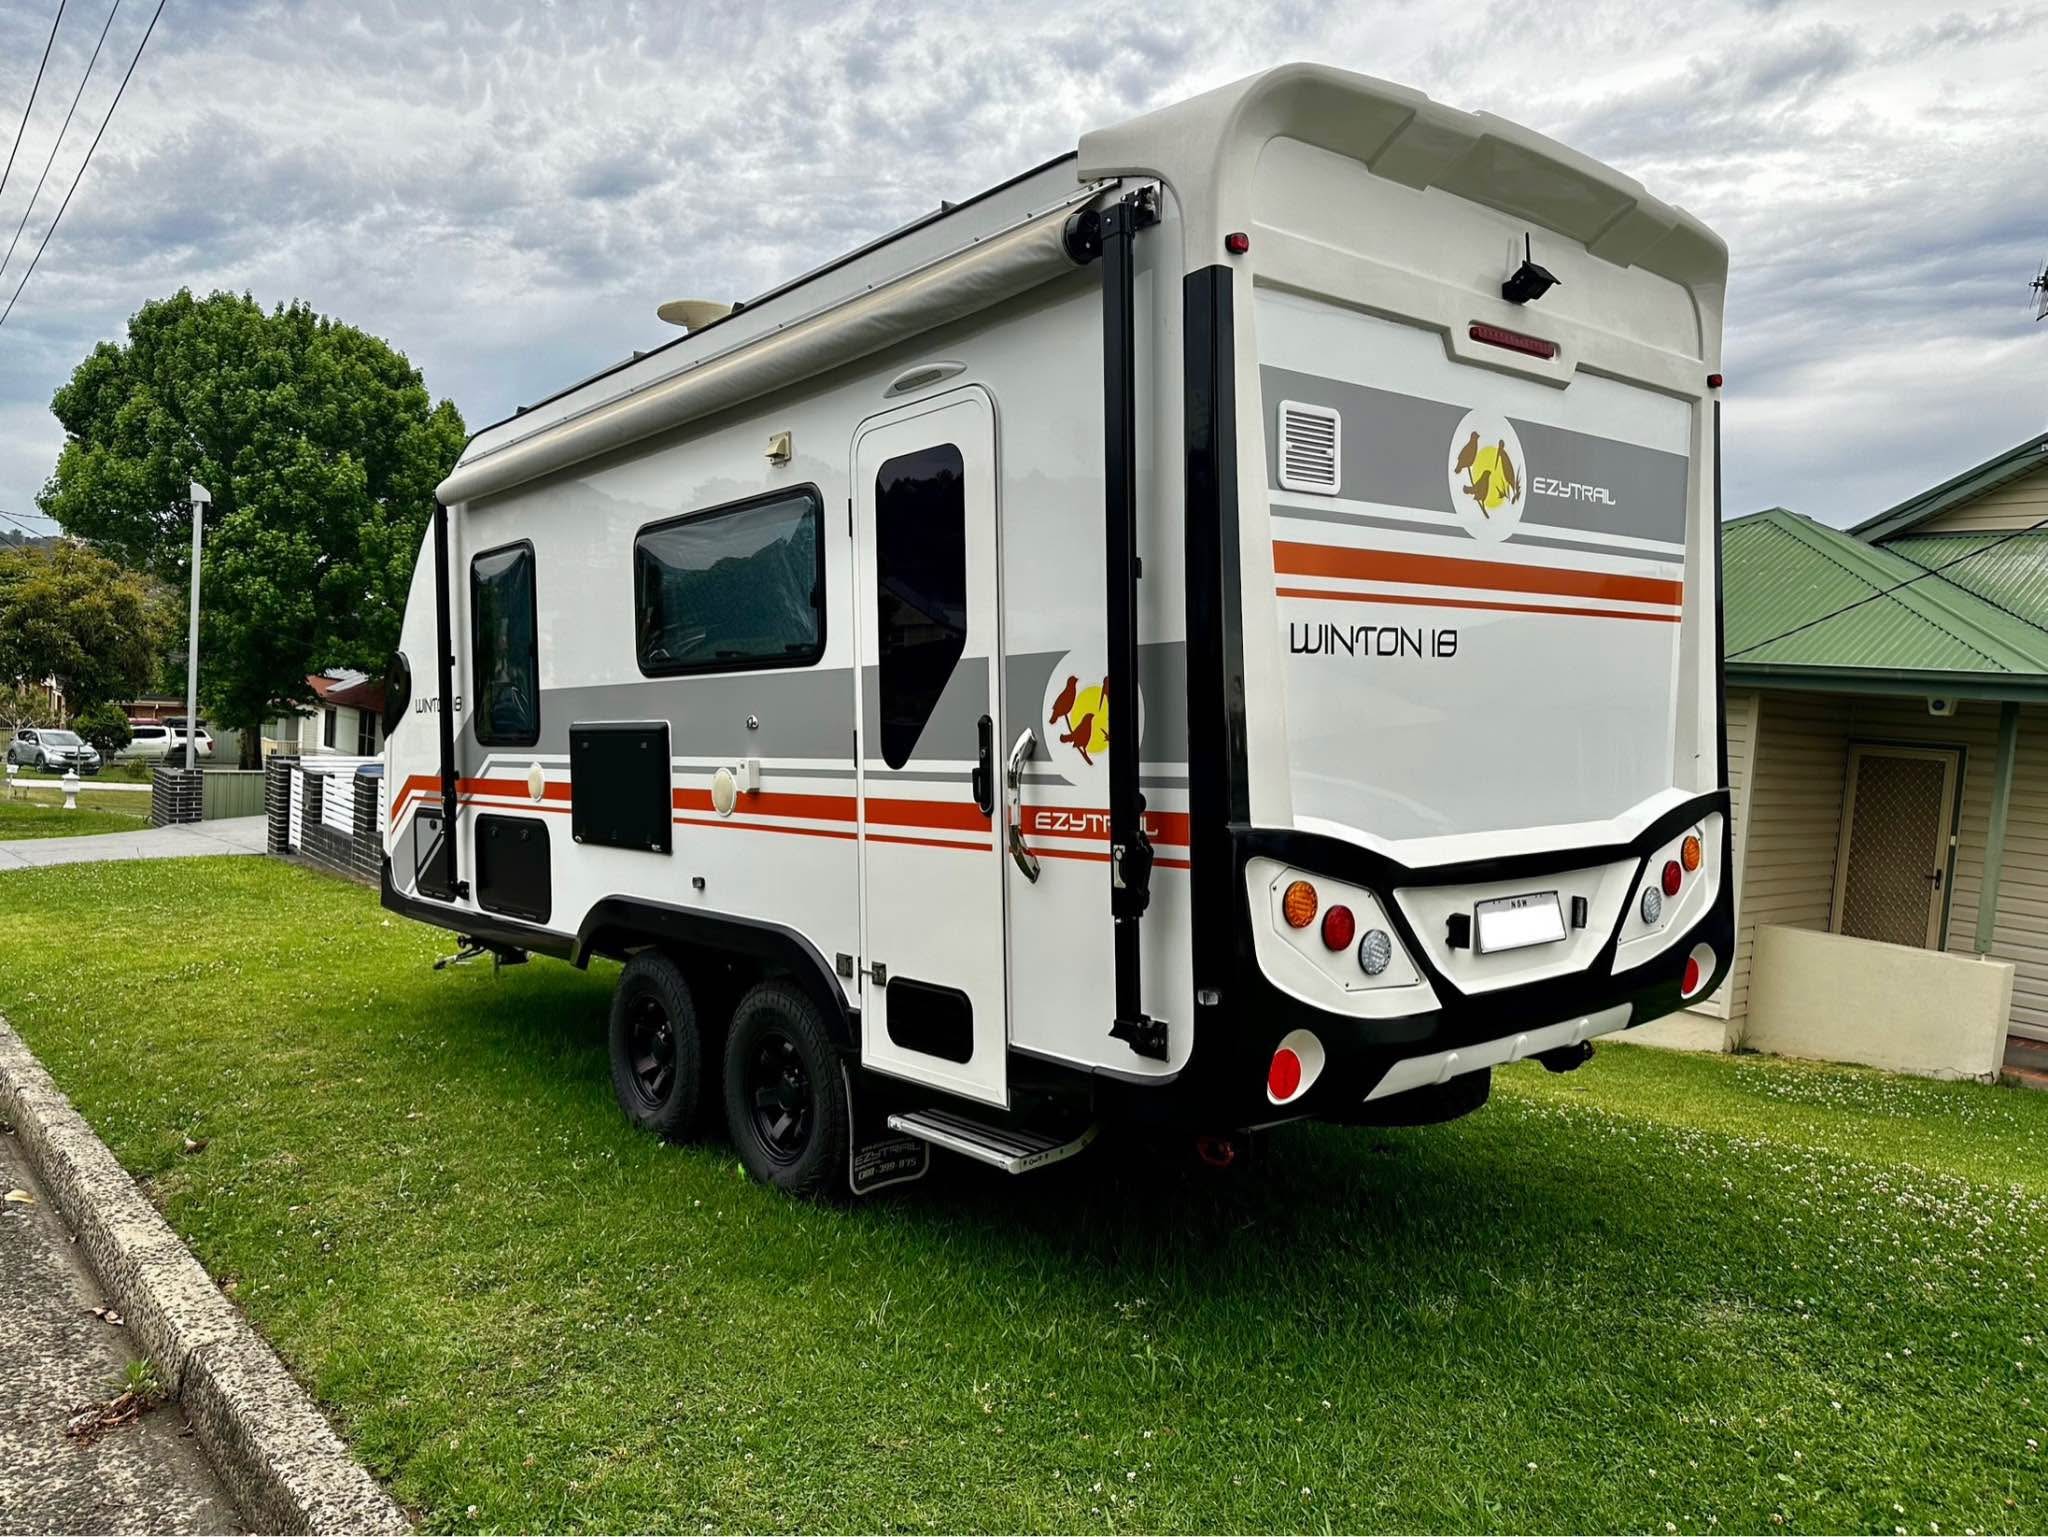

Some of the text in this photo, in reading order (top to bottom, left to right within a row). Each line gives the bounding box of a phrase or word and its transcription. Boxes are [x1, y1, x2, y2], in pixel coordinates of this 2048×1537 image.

[1533, 476, 1616, 506] EZYTRAIL
[1289, 622, 1458, 659] WINTON 18
[415, 697, 441, 713] WINT
[1035, 811, 1159, 836] EZYTIL
[1511, 899, 1527, 909] NSW
